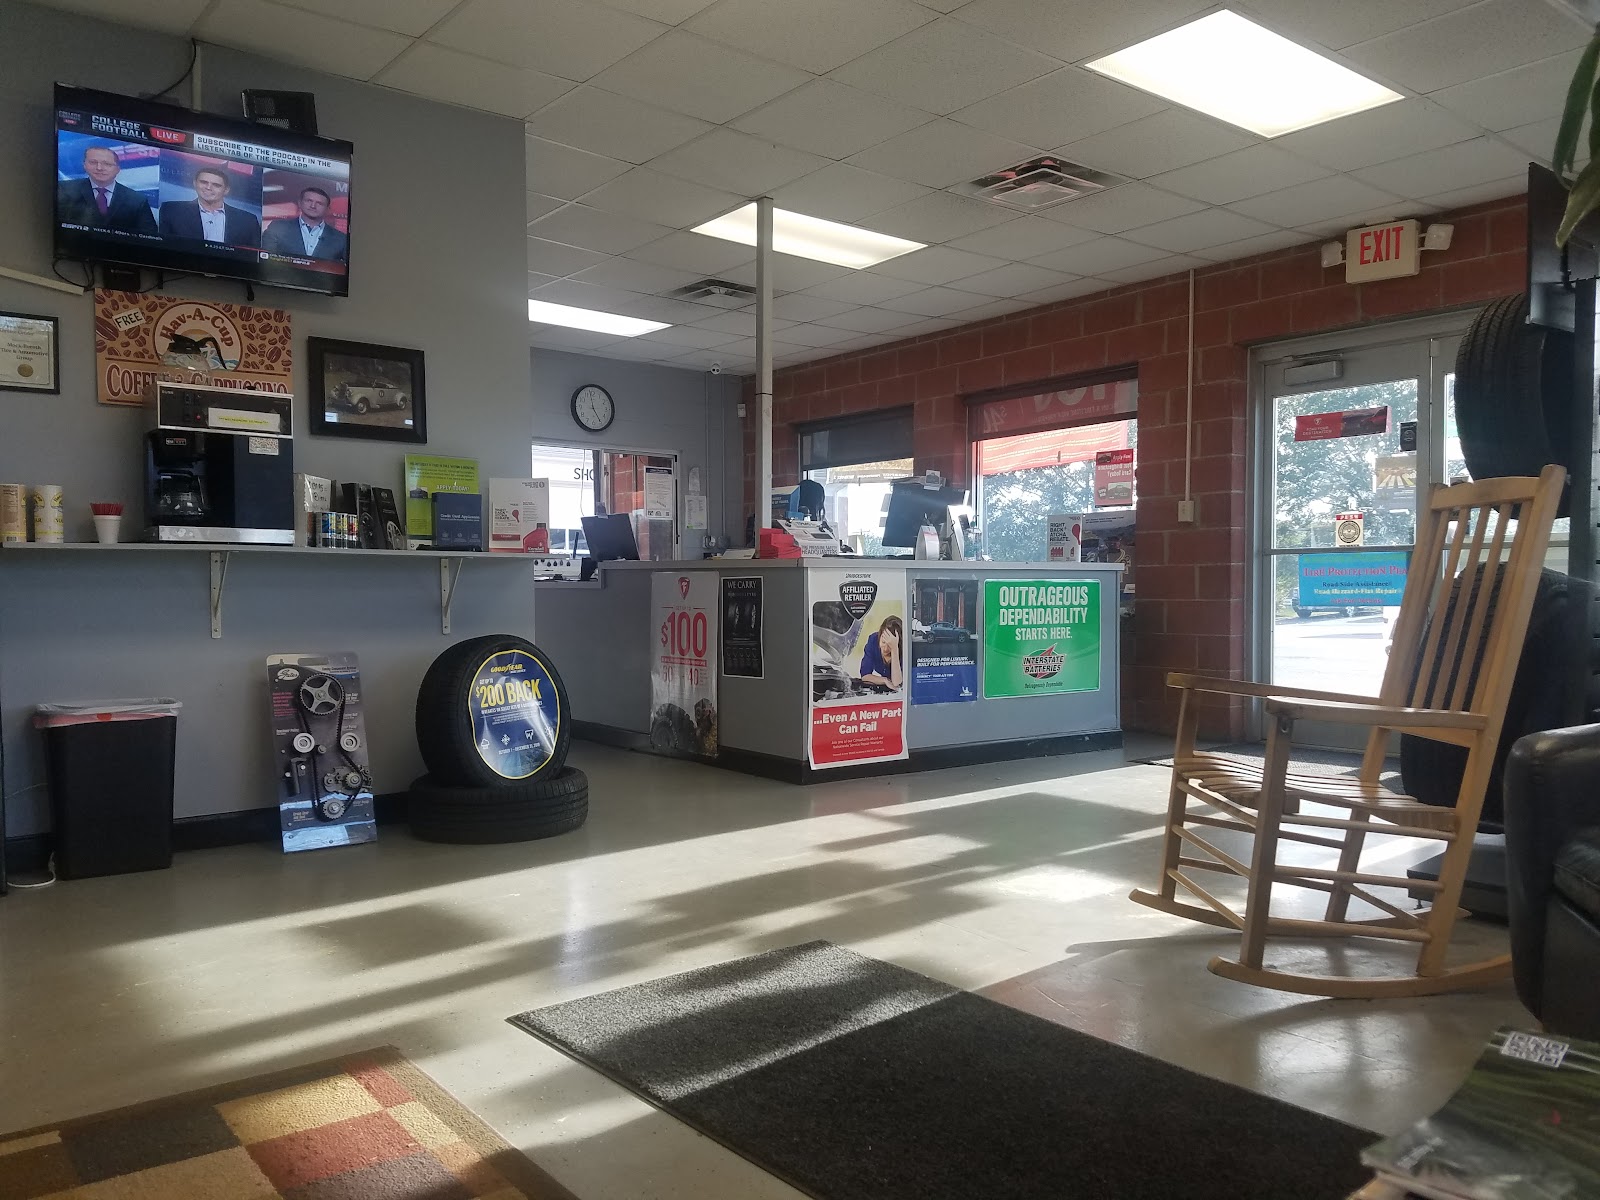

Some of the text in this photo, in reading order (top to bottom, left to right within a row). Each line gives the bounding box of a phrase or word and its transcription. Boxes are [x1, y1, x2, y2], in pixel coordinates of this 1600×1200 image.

[91, 115, 140, 130] COLLEGE
[91, 122, 148, 140] FOOTBALL
[156, 130, 179, 141] LIVE
[197, 136, 241, 151] SUBSCRIBE
[243, 145, 253, 153] TO
[255, 147, 270, 156] THE
[272, 151, 305, 163] PODCAST
[317, 159, 332, 168] THE
[197, 143, 225, 154] LISTEN
[226, 149, 241, 157] TAB
[255, 154, 270, 162] THE
[271, 157, 291, 167] ESPN
[293, 161, 308, 169] APP
[1358, 225, 1404, 266] EXIT
[114, 311, 145, 329] FREE
[159, 307, 234, 347] Hav-A-Cup
[1304, 567, 1326, 577] TIRE
[1328, 566, 1386, 577] PROTECTION
[727, 580, 757, 589] WE CARRY
[841, 585, 875, 594] AFFILIATED
[844, 593, 872, 602] RETAILER
[999, 585, 1089, 607] OUTRAGEOUS
[999, 607, 1088, 626] DEPENDABILITY
[660, 611, 707, 658] $100
[1015, 627, 1073, 641] STARTS HERE.
[490, 663, 523, 673] GOODYEAR
[1023, 655, 1065, 665] INTERSTATE
[1024, 664, 1061, 673] BATTERIES
[475, 678, 543, 708] $200 BACK
[813, 707, 902, 725] ...Even A New Part
[838, 721, 878, 735] Can Fail
